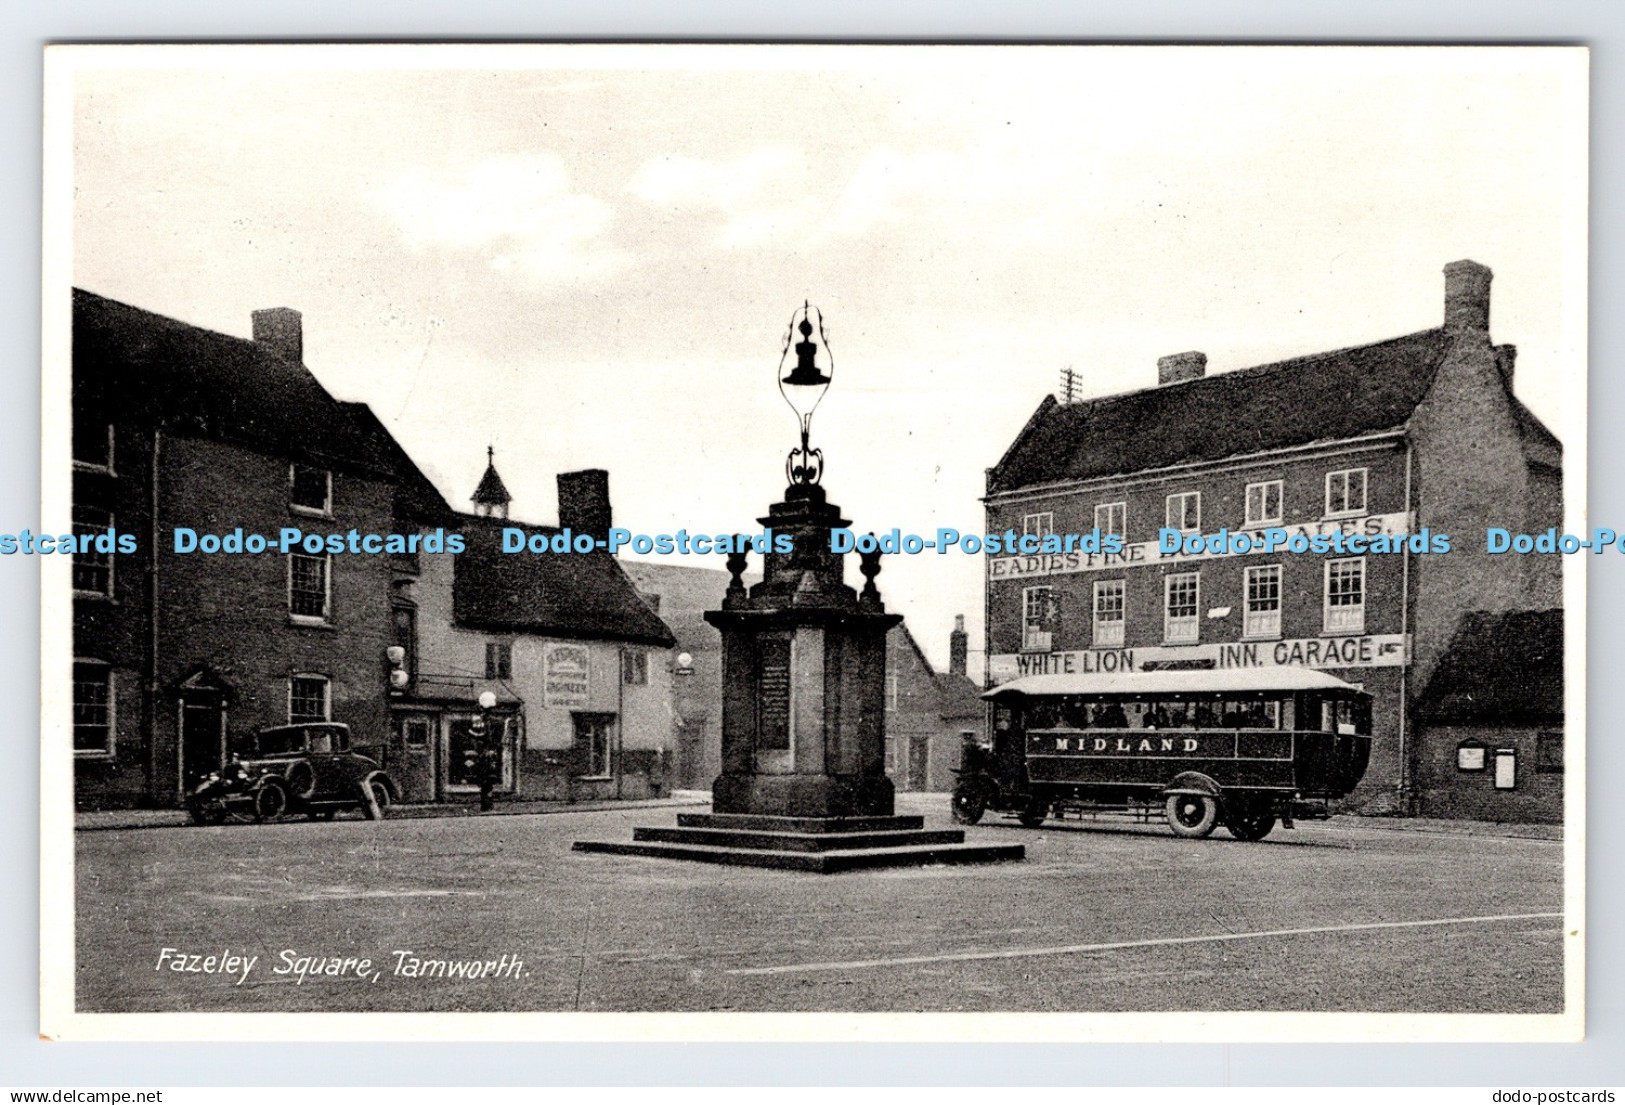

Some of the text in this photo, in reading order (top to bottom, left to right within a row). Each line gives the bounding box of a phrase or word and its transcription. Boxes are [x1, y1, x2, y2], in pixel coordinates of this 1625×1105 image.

[1016, 652, 1075, 675] WHITE
[1083, 650, 1133, 674] LION
[1273, 637, 1373, 666] GARAGE
[1055, 738, 1199, 752] MIDLAND
